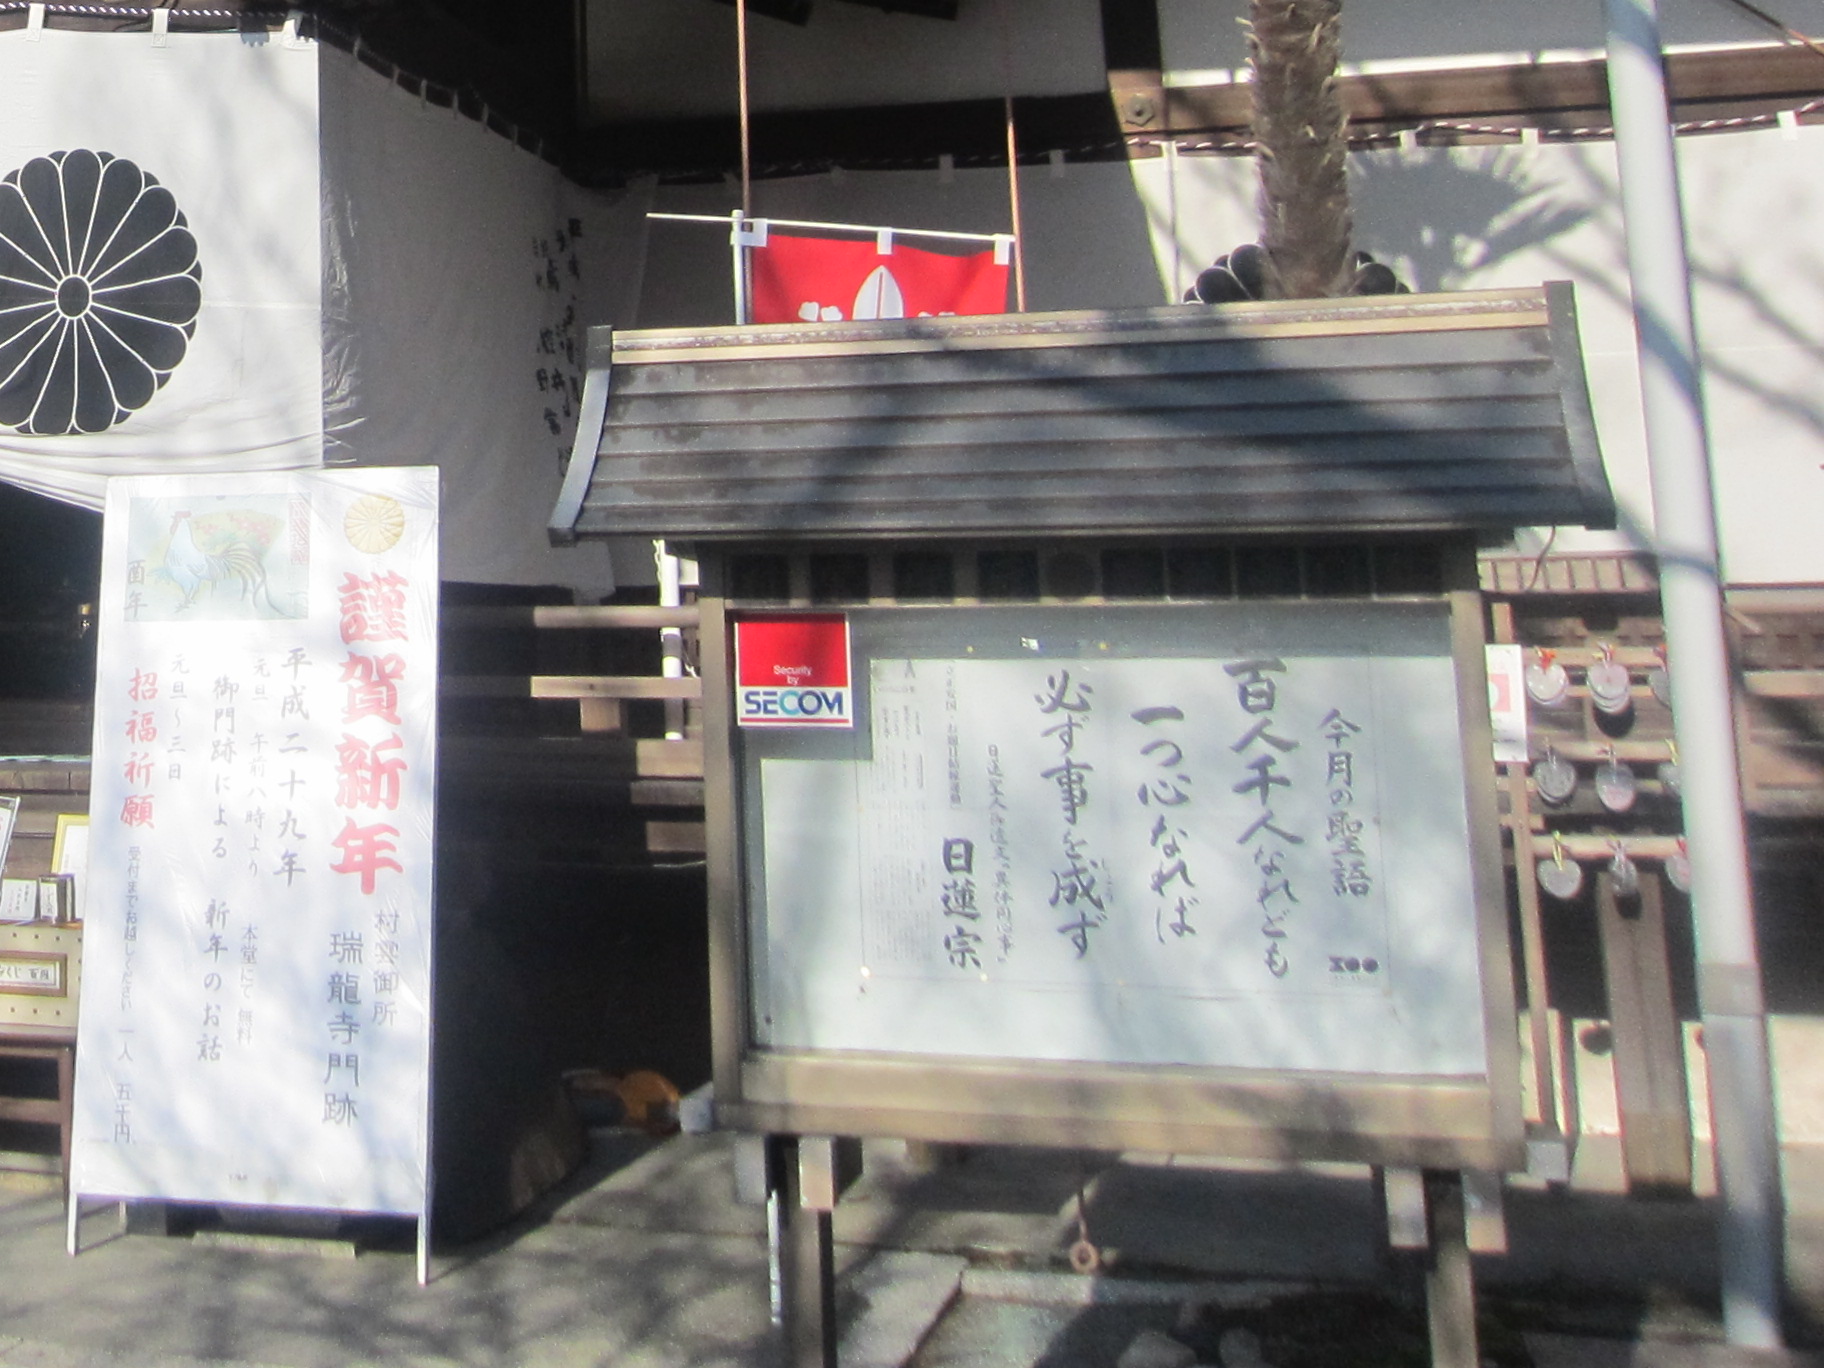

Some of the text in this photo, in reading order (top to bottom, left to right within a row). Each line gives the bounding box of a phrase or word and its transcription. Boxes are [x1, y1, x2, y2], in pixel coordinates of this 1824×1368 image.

[124, 559, 148, 618] 酉年
[773, 664, 813, 676] Security
[786, 675, 799, 686] by
[119, 667, 159, 830] 招福祈願
[272, 648, 314, 889] 平成二十九年
[329, 570, 409, 895] 謹賀新年
[744, 689, 844, 716] SECOM
[196, 675, 240, 1063] 御門跡による 新年のお話
[237, 656, 272, 1045] 元旦 午前八時より 本堂にて 無料
[1033, 668, 1109, 959] 必ず事を成ず
[1130, 705, 1202, 945] 一つ心なれば
[1223, 657, 1305, 979] 百人千人なれども
[1317, 707, 1374, 899] 今月の聖語
[28, 967, 51, 981] 百円
[940, 837, 983, 971] 日蓮宗
[113, 1082, 133, 1144] 五千円
[322, 930, 364, 1126] 瑞龍寺門跡
